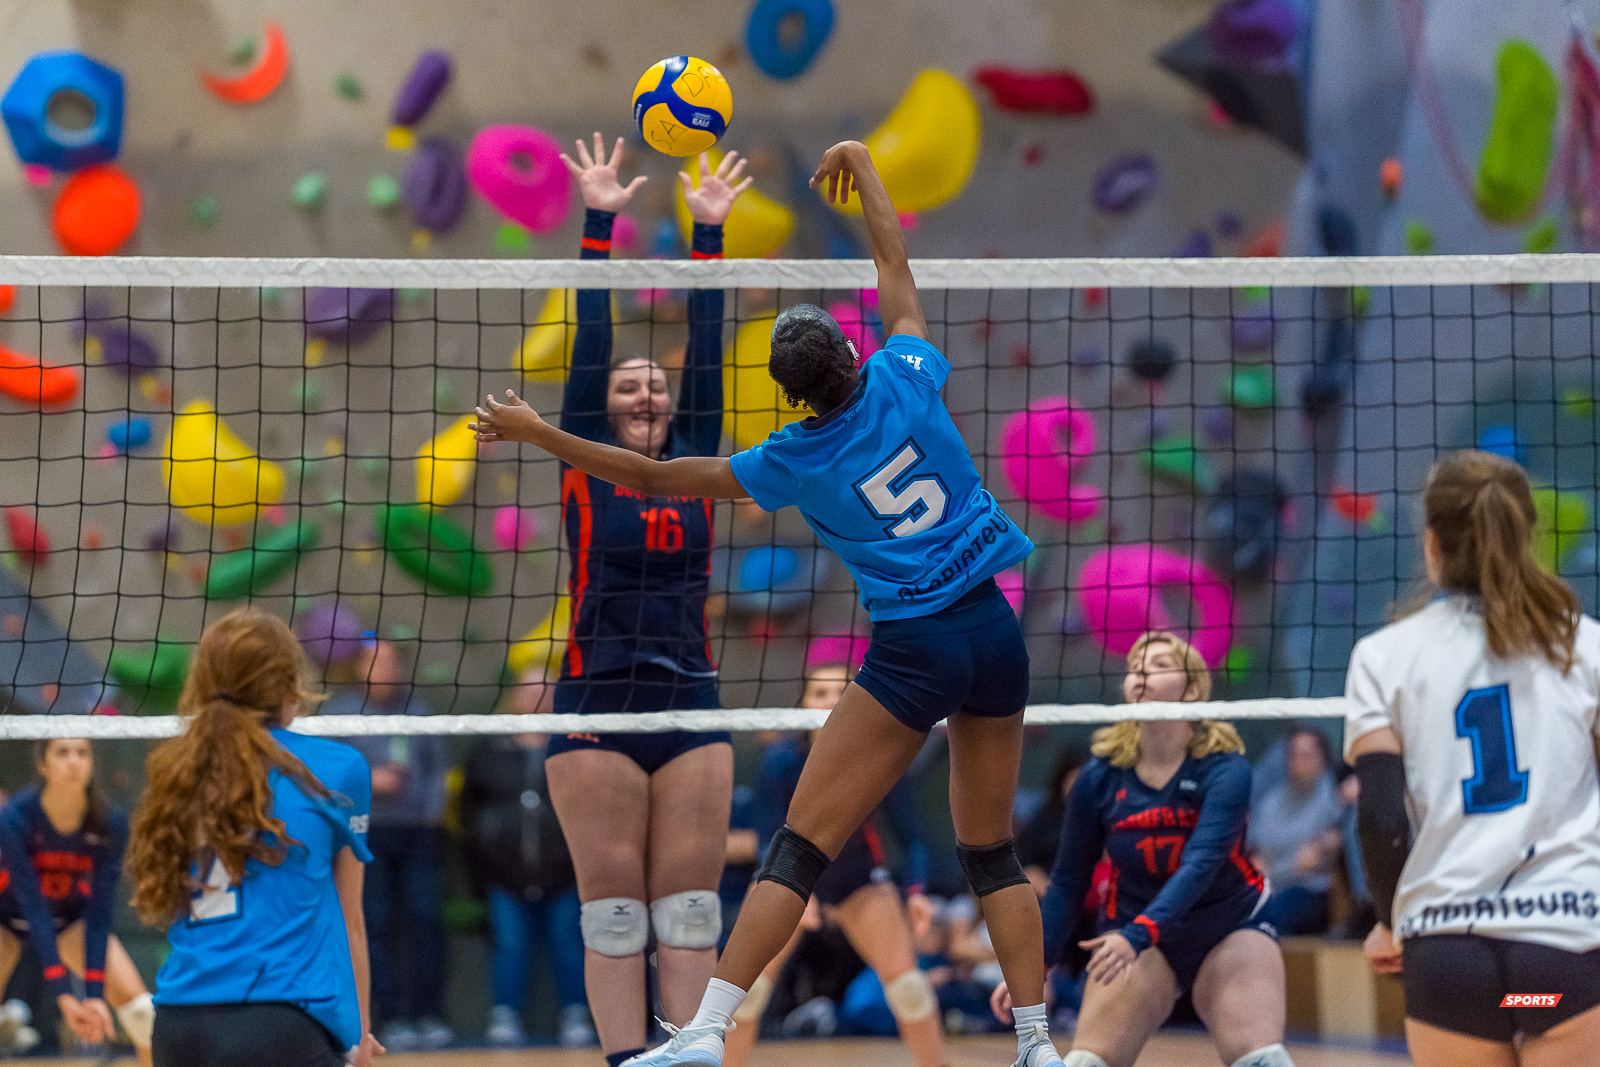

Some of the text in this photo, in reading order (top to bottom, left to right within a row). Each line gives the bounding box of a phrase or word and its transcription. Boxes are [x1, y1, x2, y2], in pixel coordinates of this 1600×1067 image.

[851, 435, 953, 539] 5
[640, 507, 684, 554] 16
[1455, 684, 1530, 815] 1
[1136, 834, 1185, 875] 17
